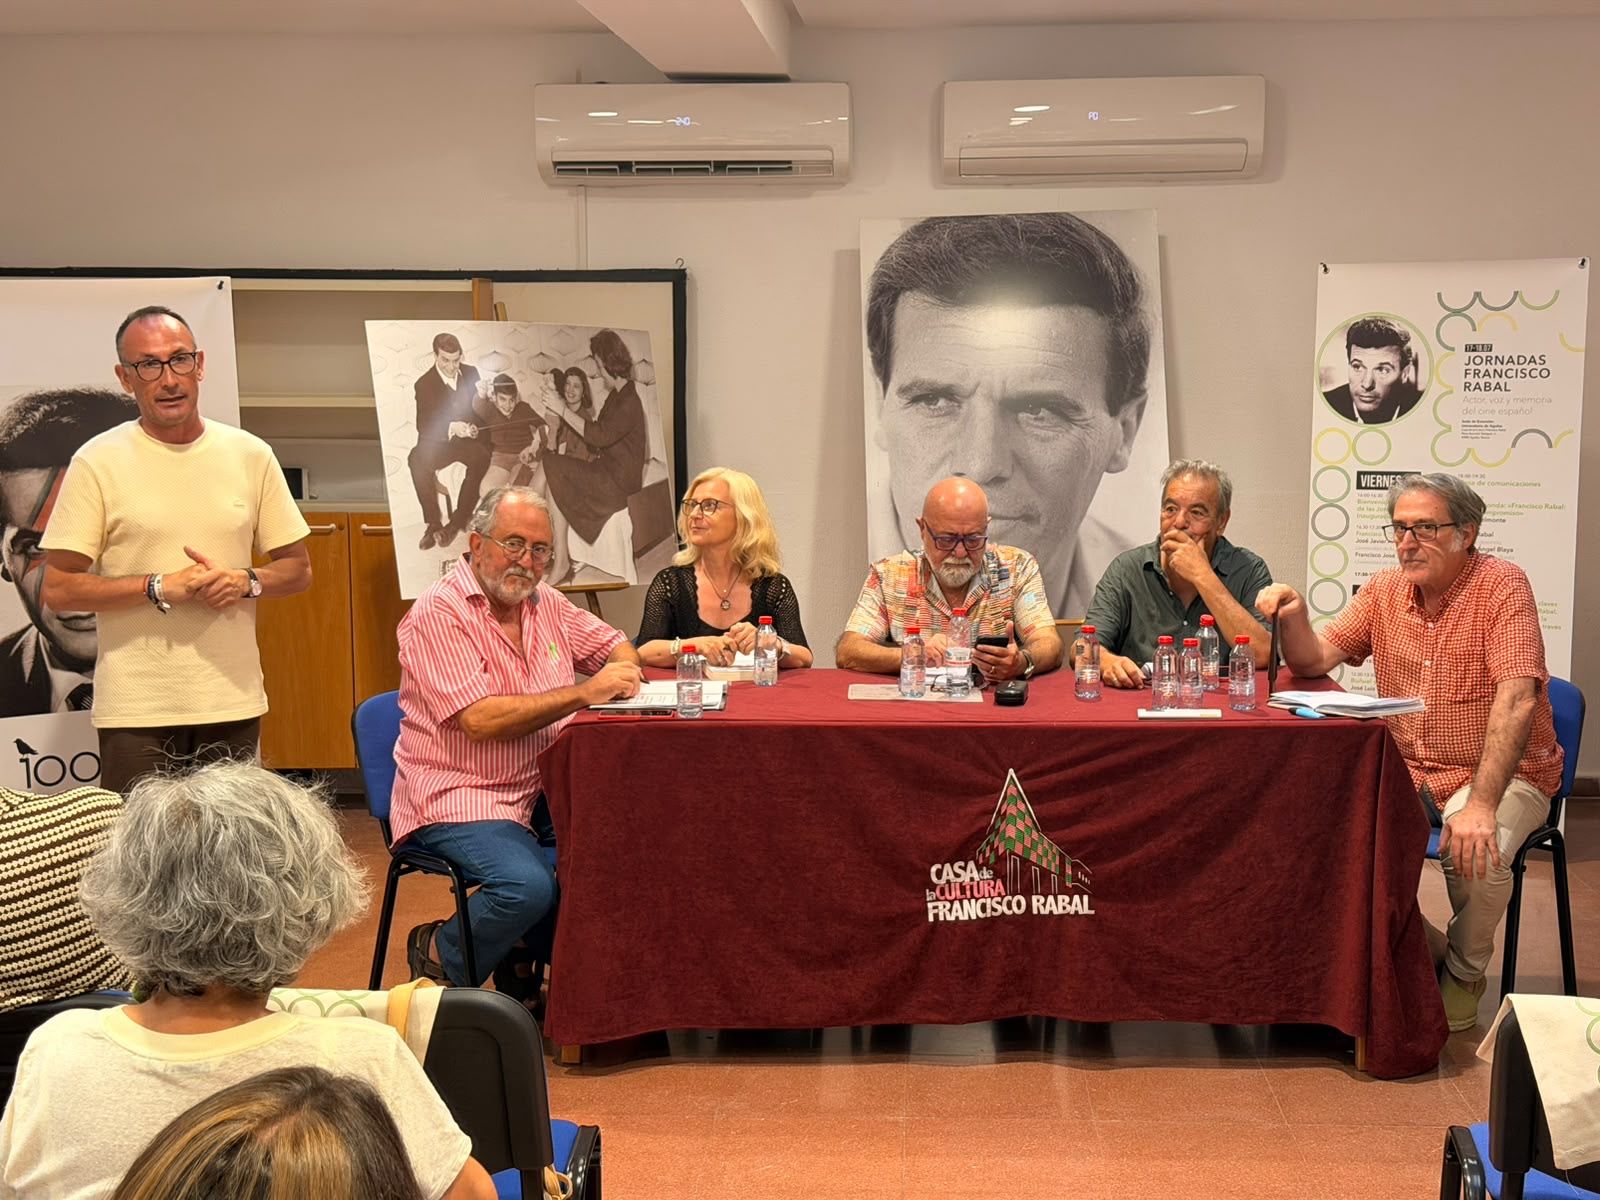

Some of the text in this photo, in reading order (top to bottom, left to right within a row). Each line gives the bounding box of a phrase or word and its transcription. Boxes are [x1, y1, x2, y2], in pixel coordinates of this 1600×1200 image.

[1464, 354, 1547, 366] JORNADAS
[1464, 368, 1551, 379] FRANCISCO
[1463, 381, 1511, 392] RABAL
[1512, 396, 1553, 404] memoria
[1462, 406, 1533, 417] del cine español
[19, 751, 101, 789] 100
[930, 860, 994, 884] CASA de
[935, 879, 1006, 901] CULTURA
[926, 894, 1096, 922] FRANCISCO RABAL
